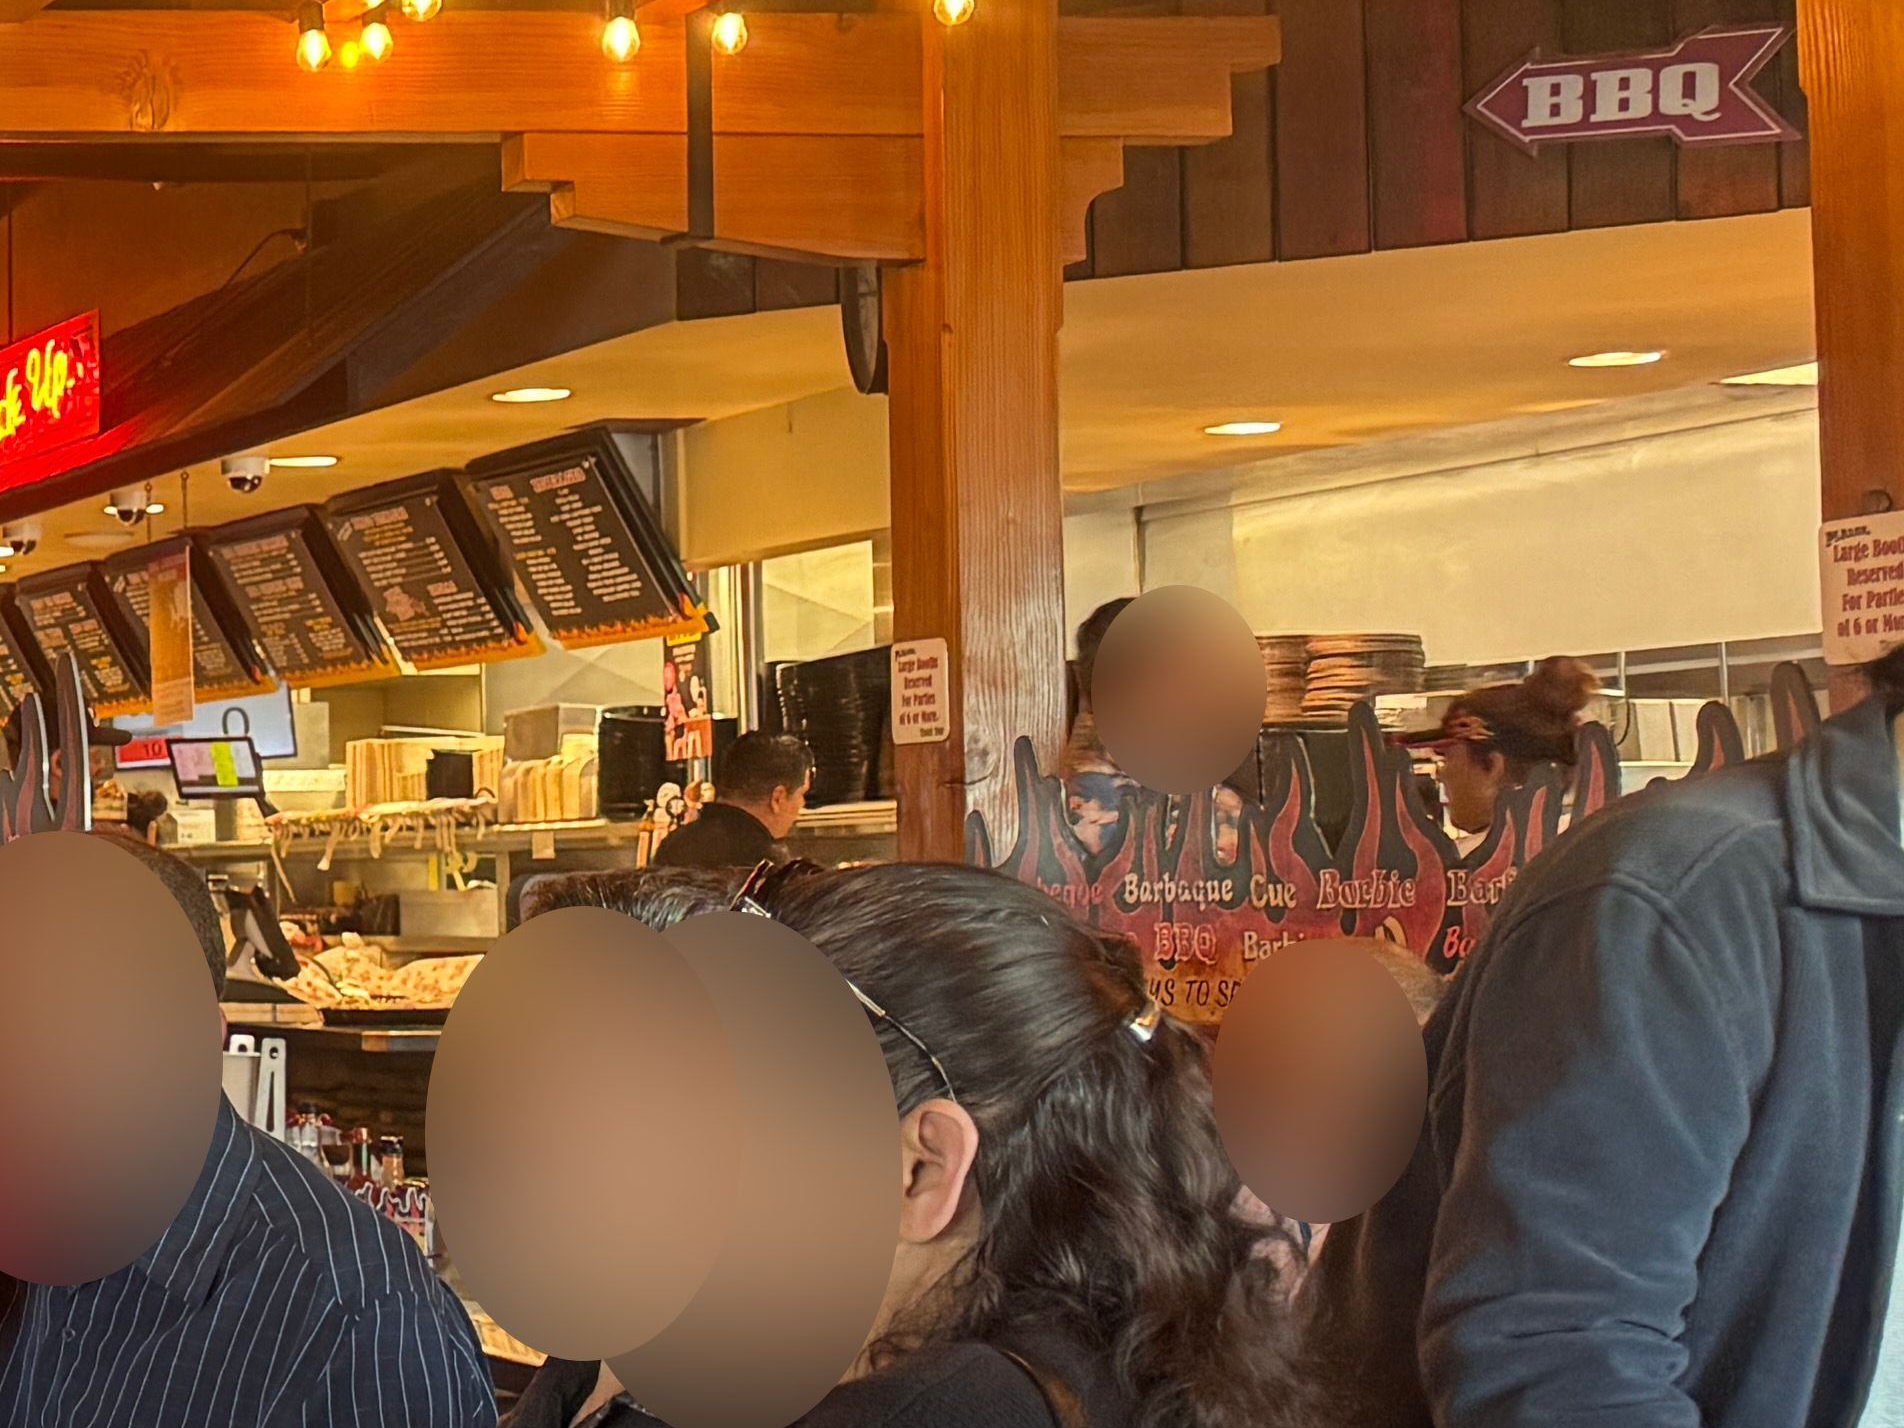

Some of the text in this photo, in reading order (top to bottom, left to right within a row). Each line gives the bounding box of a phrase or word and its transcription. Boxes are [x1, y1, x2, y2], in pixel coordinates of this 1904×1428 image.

[1521, 62, 1723, 128] BBQ
[1833, 541, 1870, 563] Large
[1842, 588, 1904, 612] For Partie
[1837, 618, 1850, 637] of
[1853, 617, 1862, 635] 6
[142, 742, 163, 756] 10
[1250, 875, 1297, 909] Cue
[1153, 922, 1217, 964] BBQ
[1186, 979, 1210, 1007] TO
